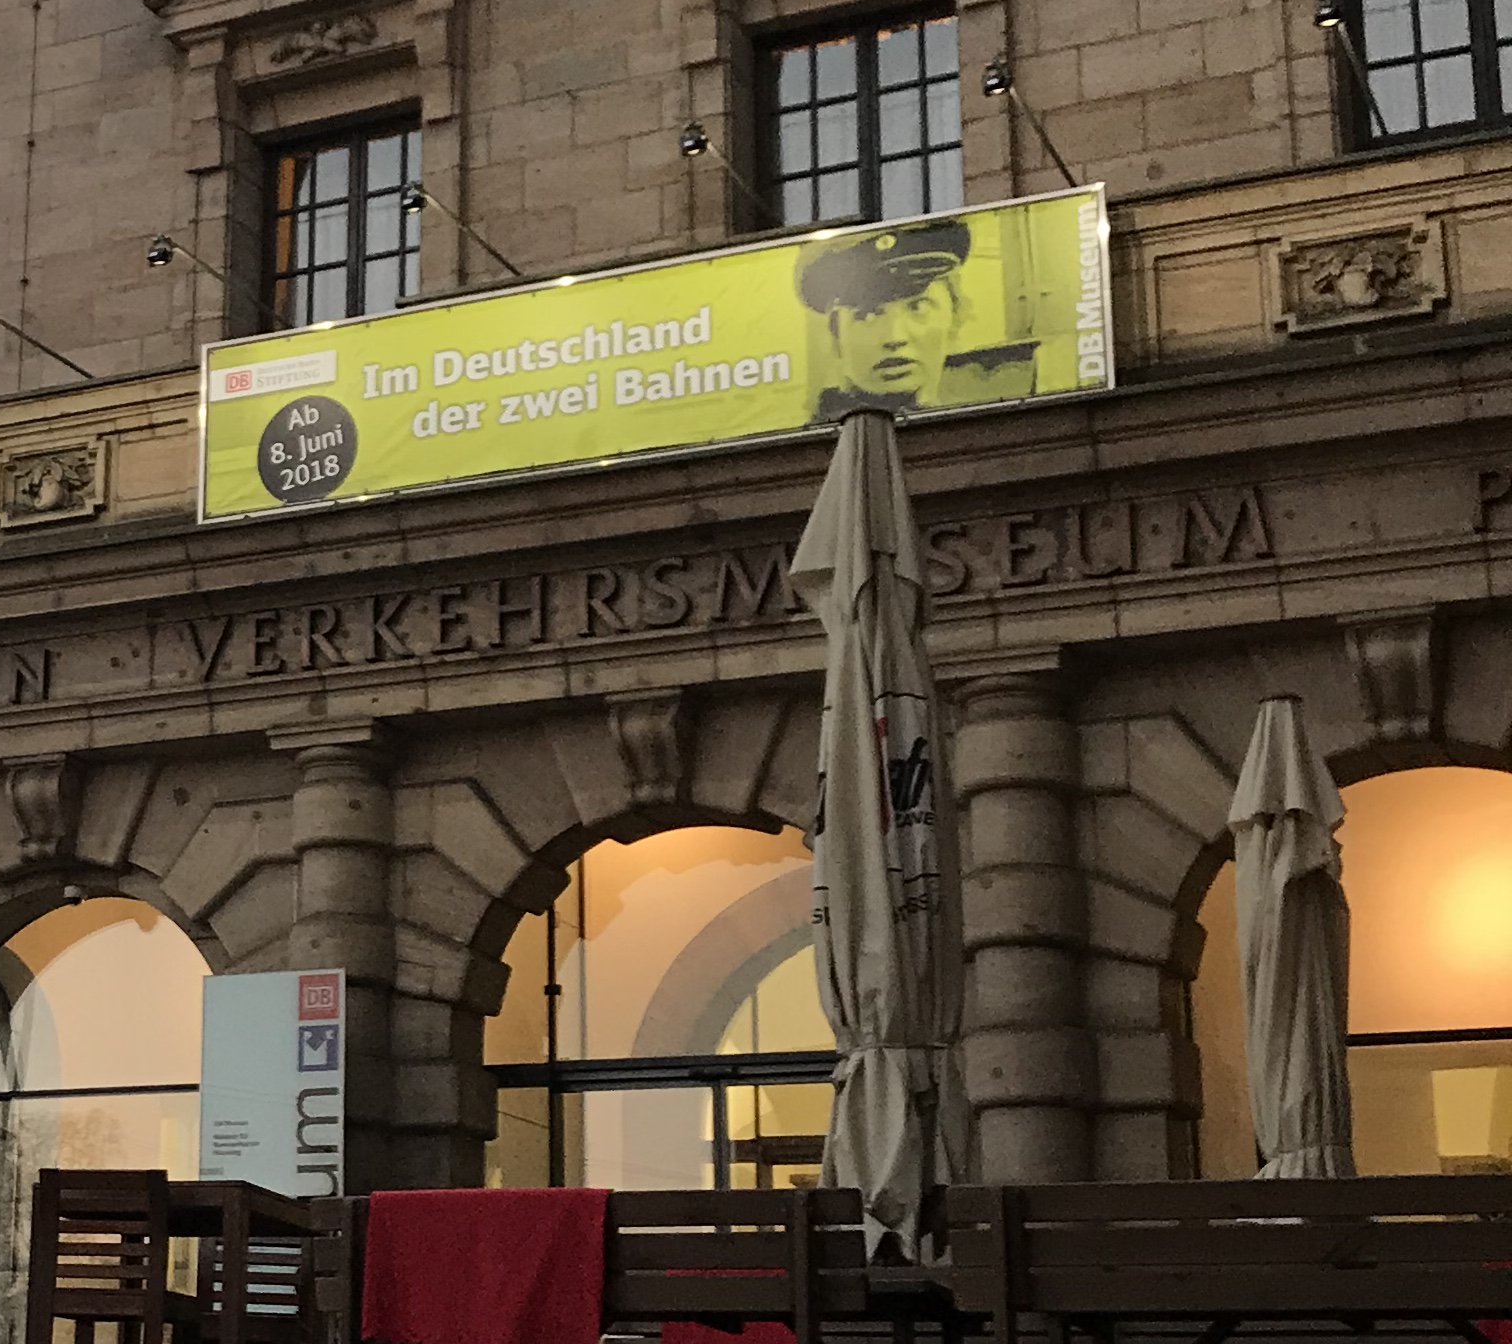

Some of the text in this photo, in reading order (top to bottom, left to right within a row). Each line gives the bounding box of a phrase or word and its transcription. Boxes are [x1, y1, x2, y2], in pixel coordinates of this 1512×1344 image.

[1076, 201, 1106, 379] DB Museum
[362, 305, 713, 399] Im Deutschland
[228, 372, 251, 391] DB
[412, 352, 790, 439] der zwei Bahnen
[288, 404, 320, 431] Ab
[270, 424, 344, 464] 8. Juni
[279, 455, 340, 491] 2018
[185, 485, 1275, 683] VERKEHRSMSEUM
[306, 987, 333, 1007] DB
